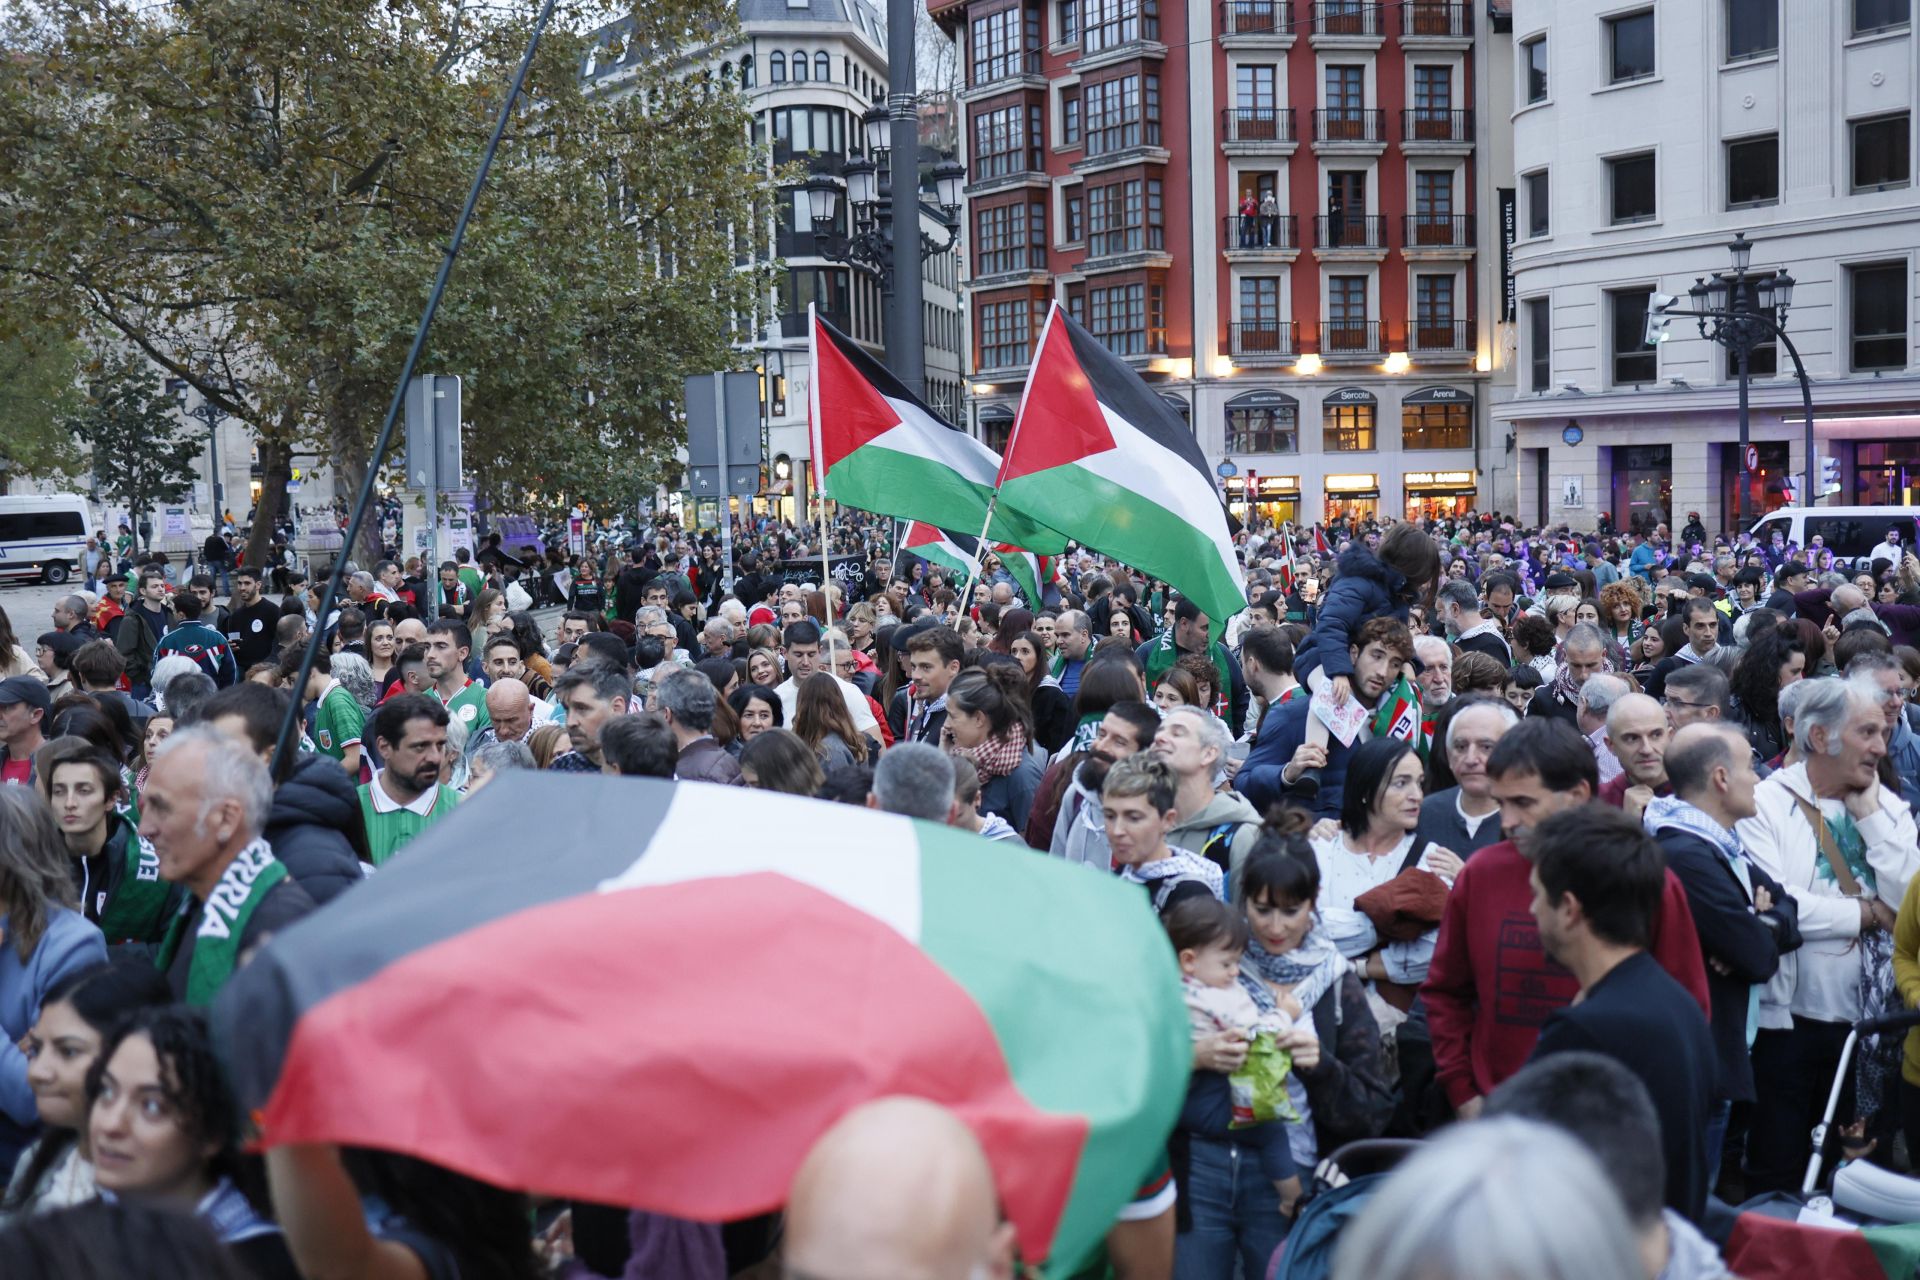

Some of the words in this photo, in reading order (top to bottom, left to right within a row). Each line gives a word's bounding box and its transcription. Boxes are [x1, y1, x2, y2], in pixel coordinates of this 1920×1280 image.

[1505, 202, 1513, 229] HOTEL
[1341, 391, 1370, 400] Sercotel
[1433, 389, 1456, 399] Arenal
